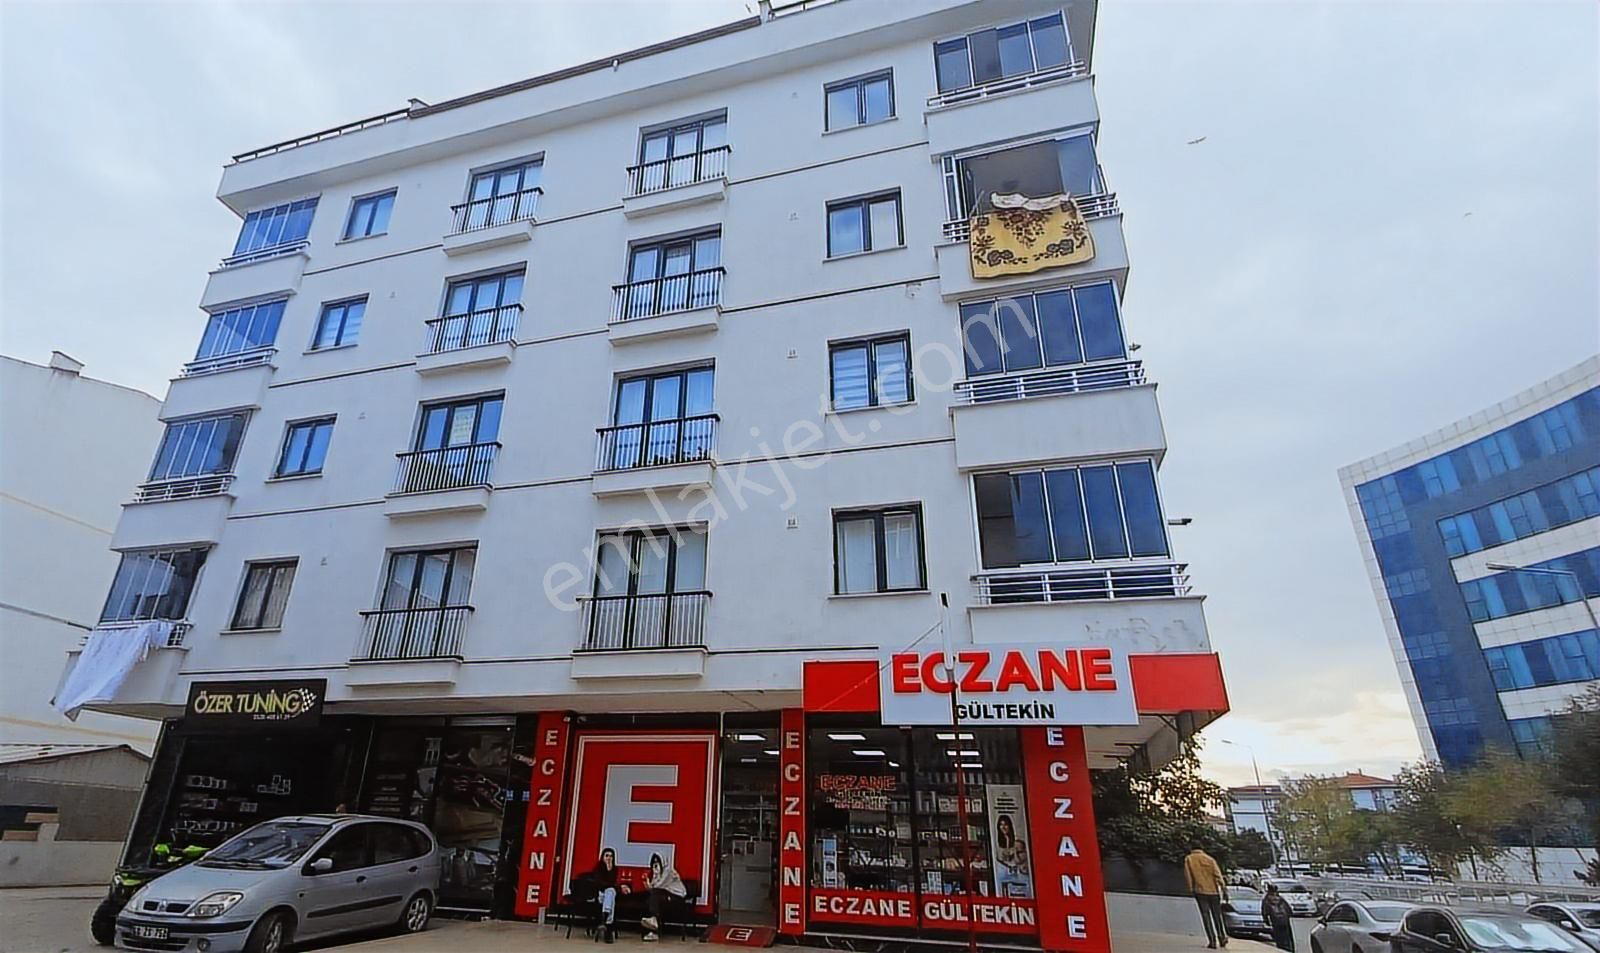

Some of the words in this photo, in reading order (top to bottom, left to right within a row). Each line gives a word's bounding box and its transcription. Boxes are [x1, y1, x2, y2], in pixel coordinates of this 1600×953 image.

[892, 649, 1117, 693] ECZANE
[194, 690, 233, 713] ÖZER
[236, 688, 300, 713] TUNİNG
[955, 700, 1055, 719] GÜLTEKİN
[820, 775, 896, 790] ECZANE
[526, 730, 559, 903] ECZANE
[600, 764, 679, 867] E
[784, 732, 801, 923] ECZANE
[1046, 727, 1087, 938] ECZANE
[815, 895, 911, 917] ECZANE
[924, 899, 1035, 925] GÜLTEKİN
